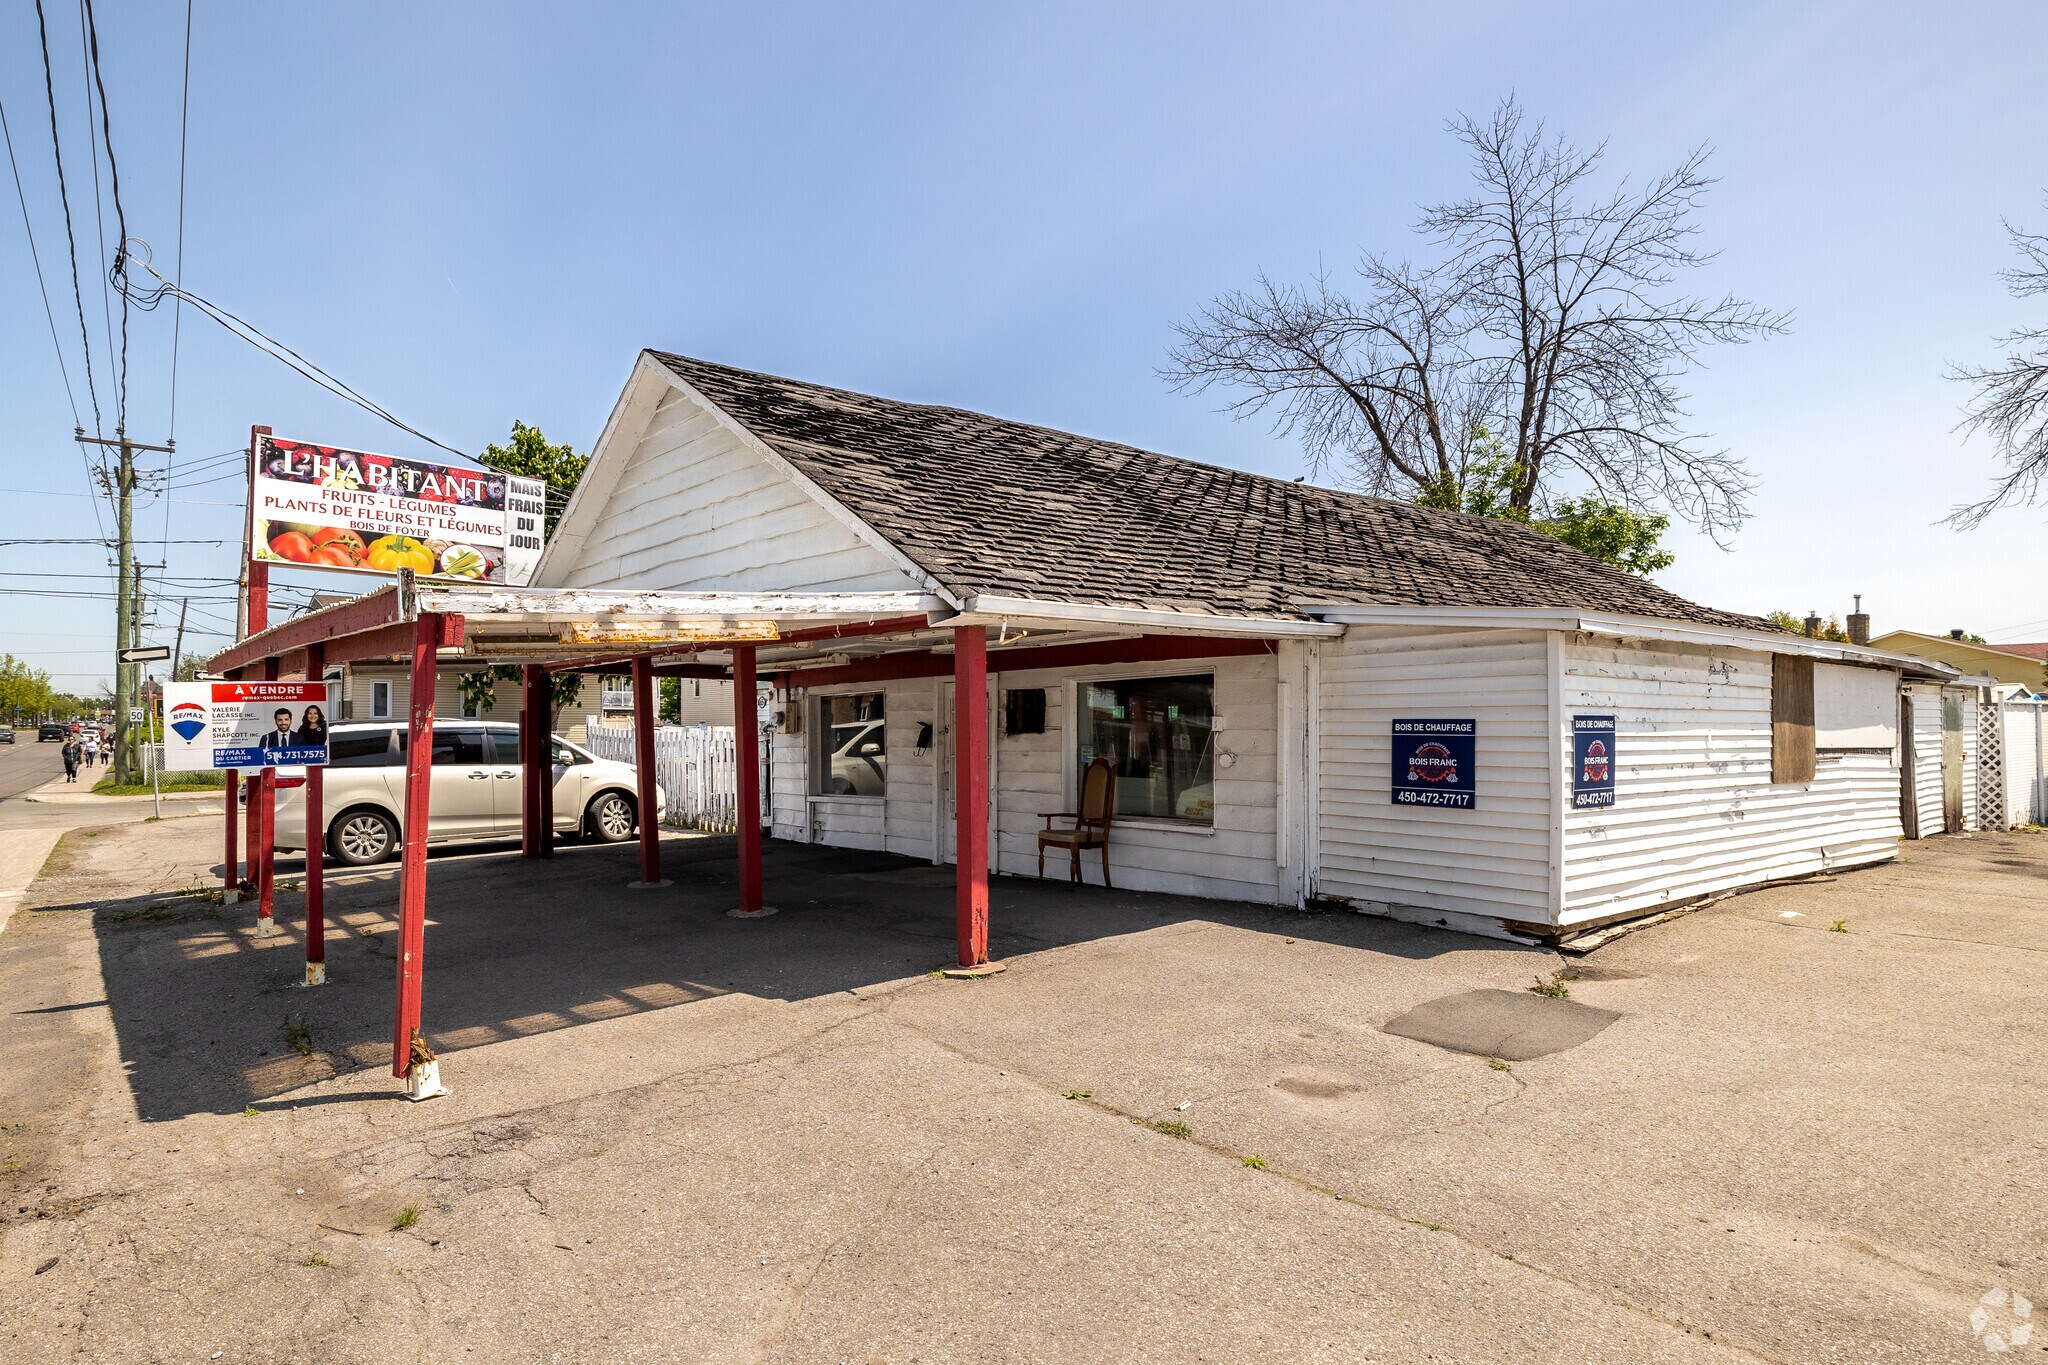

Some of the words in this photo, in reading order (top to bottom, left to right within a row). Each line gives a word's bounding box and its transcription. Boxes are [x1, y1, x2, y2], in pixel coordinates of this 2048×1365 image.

[283, 449, 487, 502] L'HABITANT
[510, 480, 542, 498] MAÏS
[322, 489, 376, 506] FRUITS
[390, 496, 456, 517] LÉGUMES
[508, 498, 544, 515] FRAIS
[264, 496, 328, 514] PLANTS
[332, 505, 352, 517] DE
[358, 508, 412, 524] FLEURS
[418, 516, 434, 527] ET
[439, 517, 502, 536] LÉGUMES
[350, 520, 375, 531] BOIS
[378, 524, 392, 533] DE
[395, 526, 430, 538] FOYER
[517, 517, 535, 532] DU
[509, 534, 541, 550] JOUR
[235, 684, 244, 695] À
[250, 686, 304, 695] VENDRE
[131, 712, 142, 720] 50
[174, 712, 204, 720] RE/MAX
[1395, 723, 1412, 731] BOIS
[1414, 723, 1424, 731] DE
[1425, 723, 1472, 732] CHAUFFAGE
[1409, 758, 1428, 766] BOIS
[1429, 758, 1458, 766] FRANC
[1398, 791, 1469, 806] 450-472-7717
[1576, 792, 1612, 806] 450-472-7717
